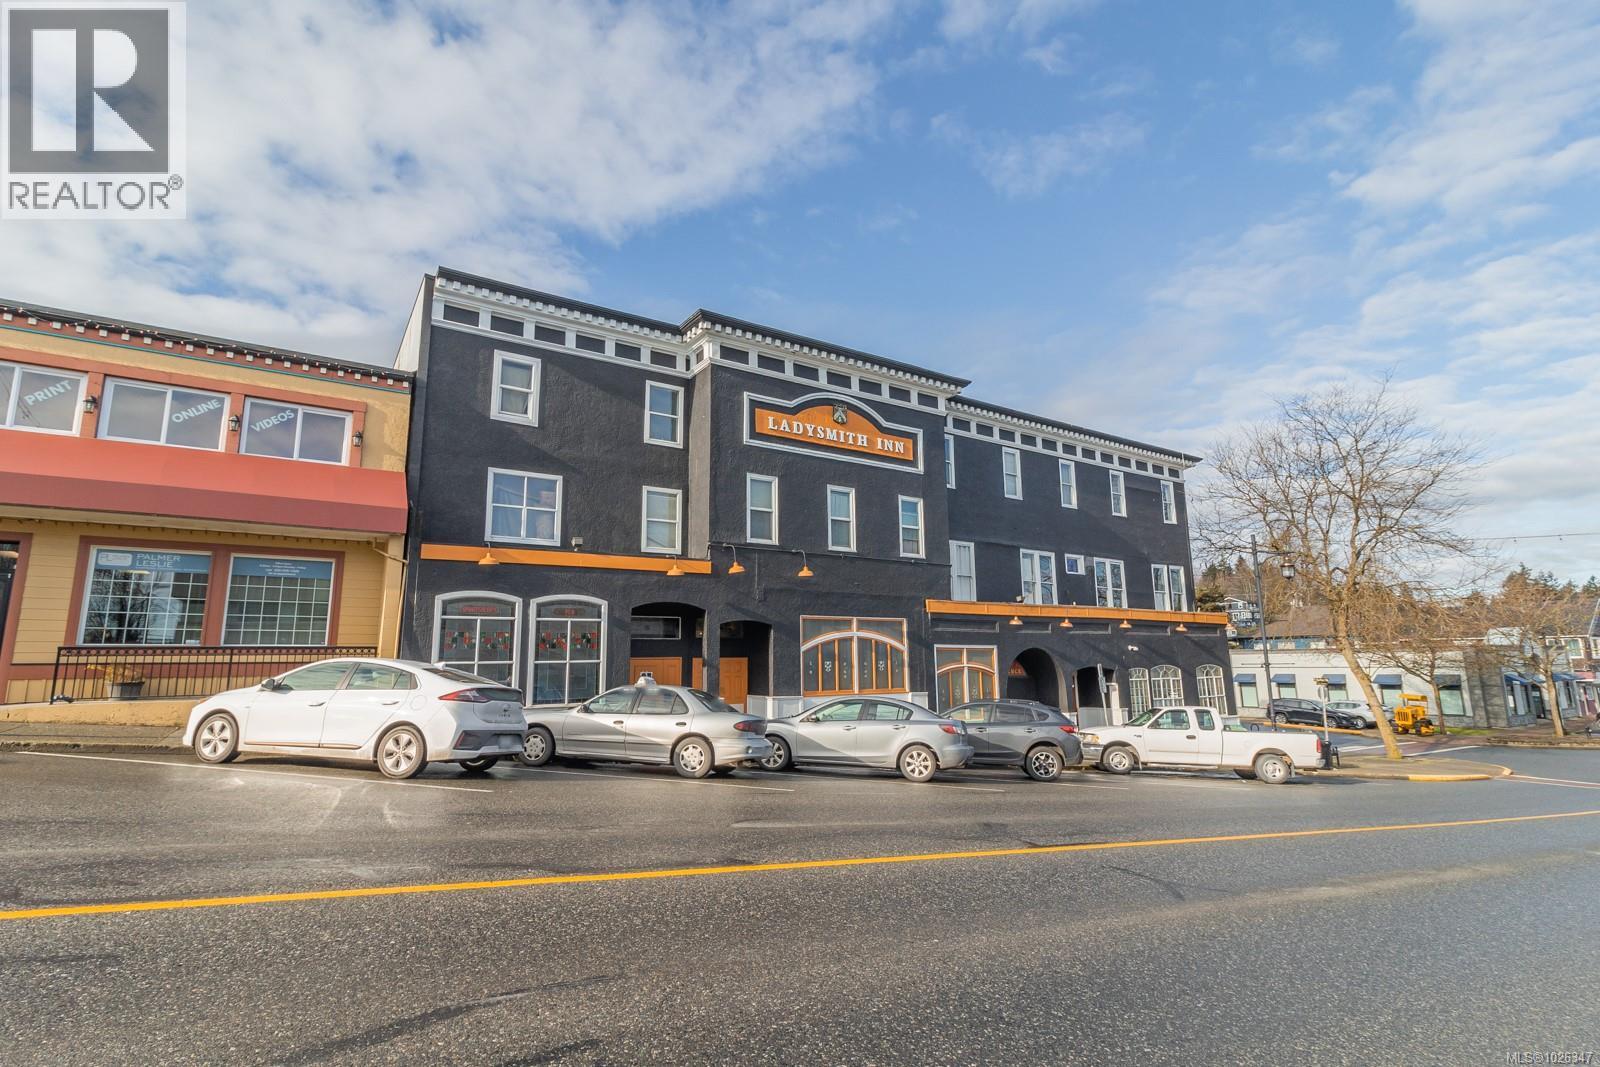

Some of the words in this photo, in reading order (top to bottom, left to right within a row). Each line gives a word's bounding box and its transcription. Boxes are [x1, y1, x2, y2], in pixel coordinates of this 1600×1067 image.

[24, 380, 72, 406] PRINT
[172, 398, 222, 423] ONLINE
[250, 410, 294, 432] VIDEOS
[767, 415, 868, 447] LADYSMITH
[876, 437, 905, 454] INN
[136, 552, 181, 562] PALMER
[136, 560, 173, 568] LESLIE
